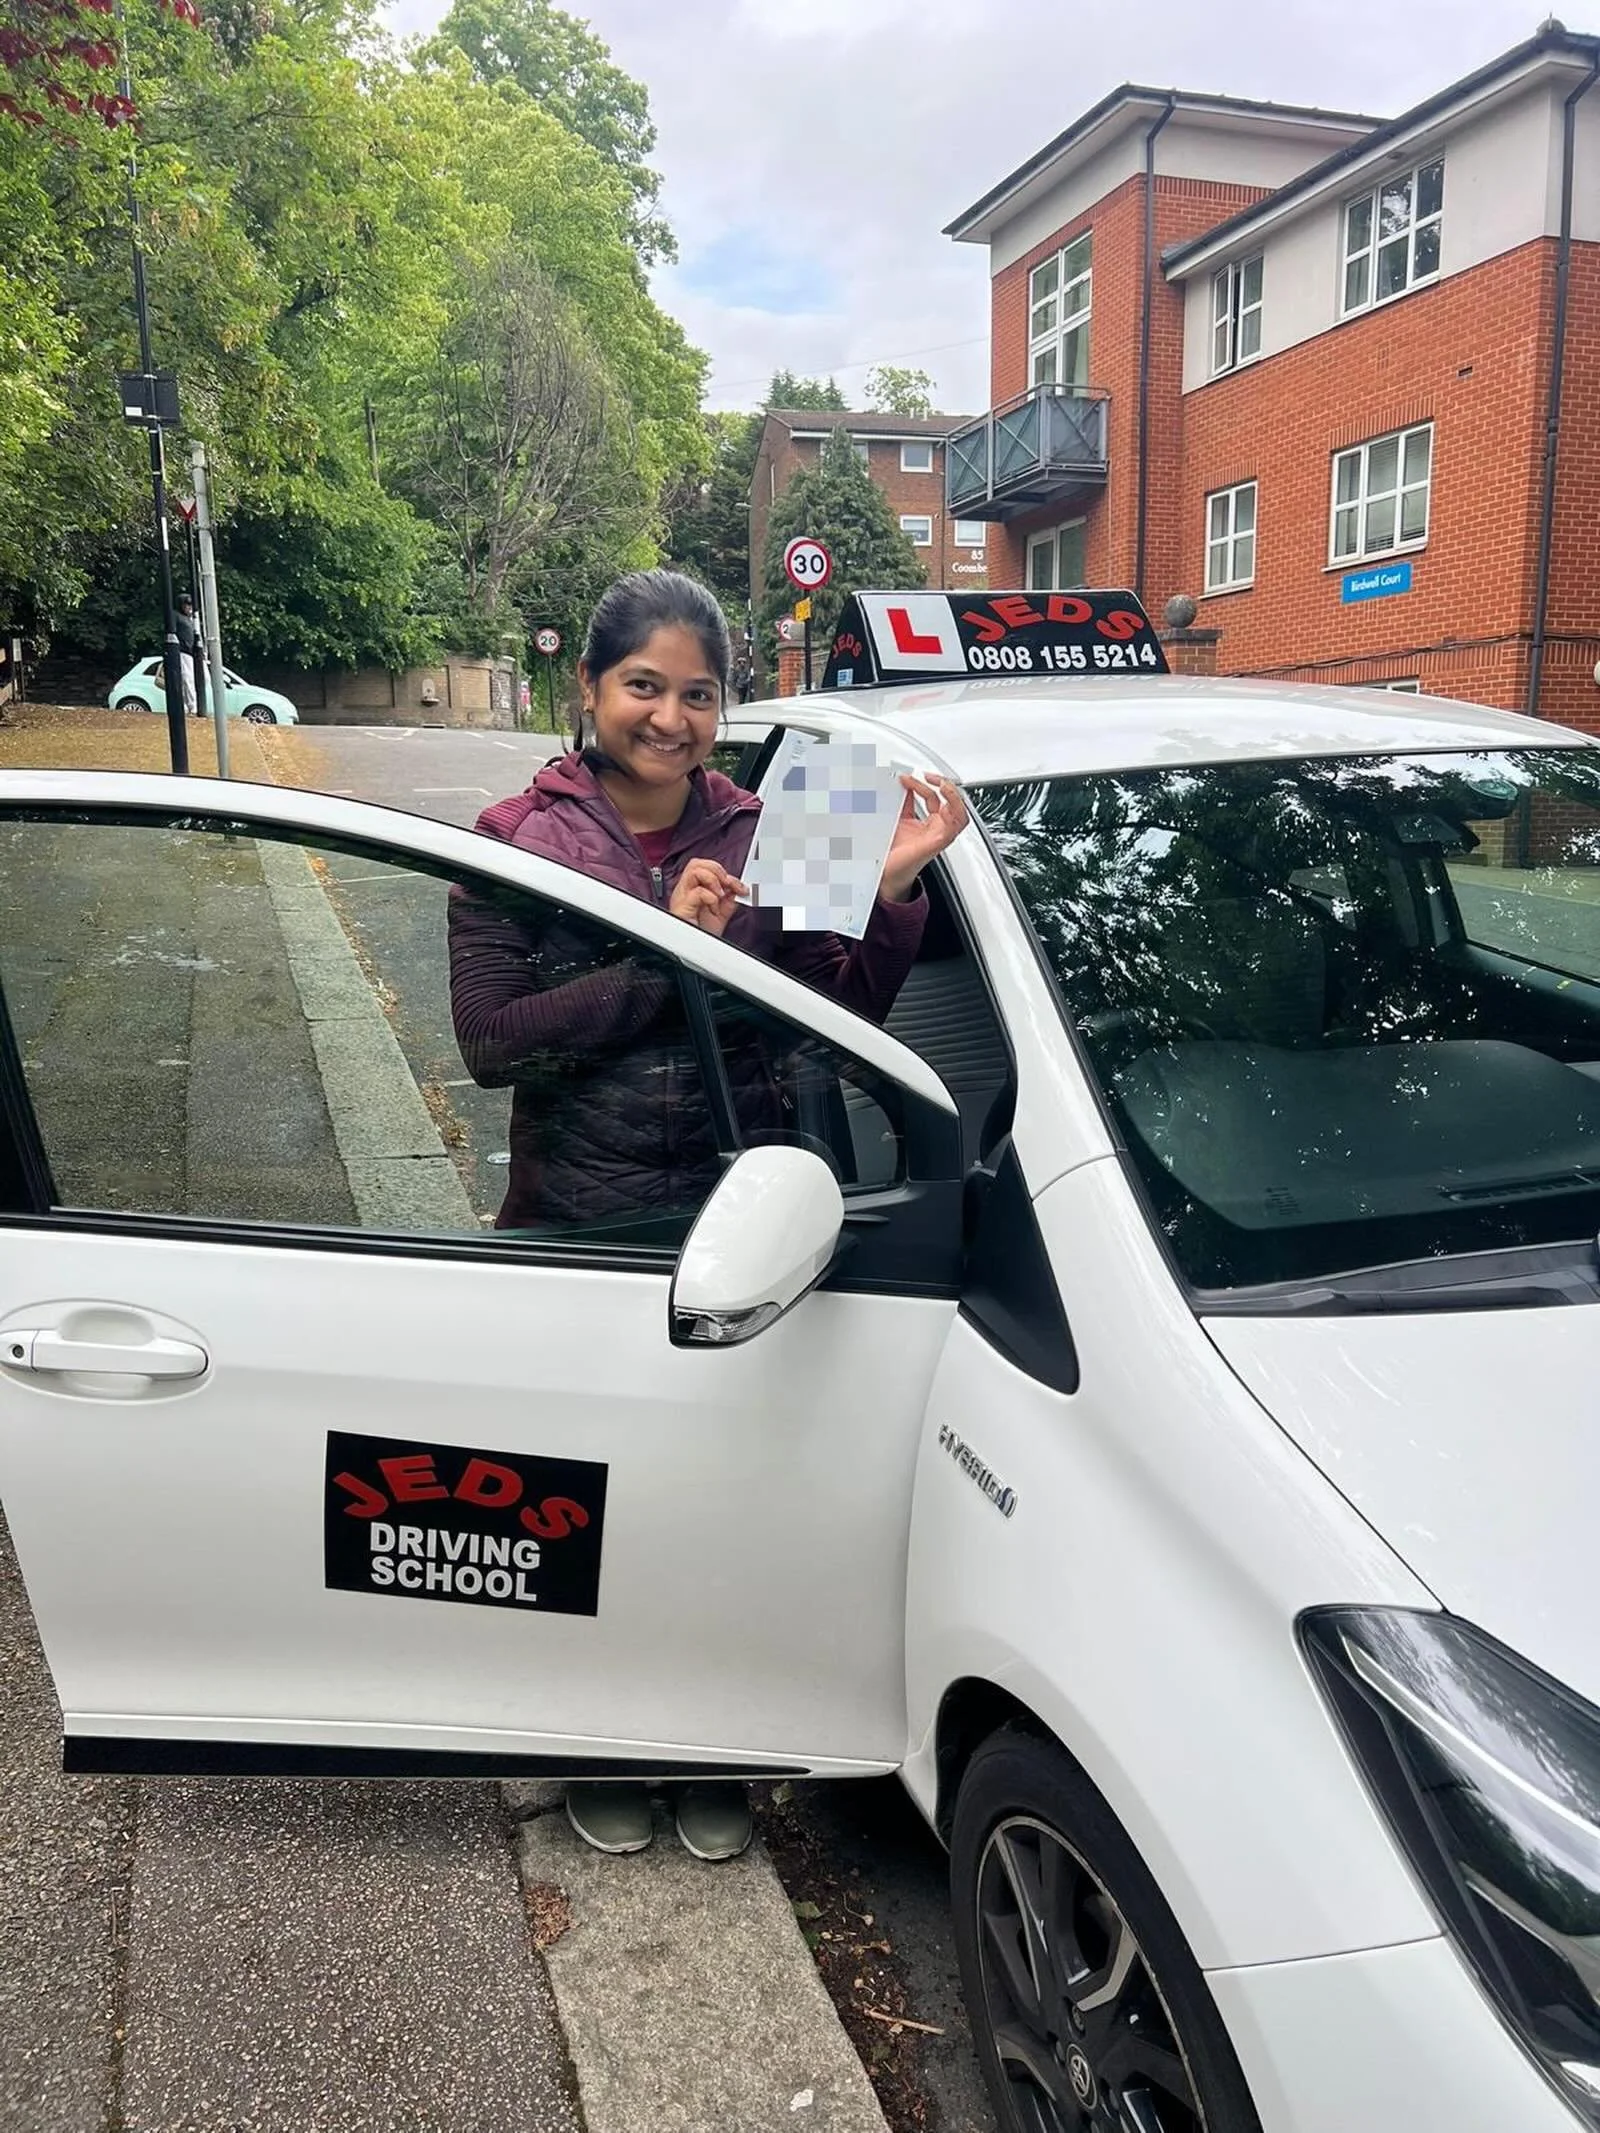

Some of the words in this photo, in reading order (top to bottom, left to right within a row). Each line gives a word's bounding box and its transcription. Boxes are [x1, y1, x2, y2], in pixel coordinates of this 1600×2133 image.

[793, 554, 825, 574] 30
[971, 550, 984, 560] 85
[1380, 573, 1402, 586] Court
[886, 608, 943, 655] L
[960, 595, 1145, 641] JEDS
[541, 635, 558, 647] 20
[832, 634, 862, 660] JEDS
[968, 645, 1033, 670] 0808
[1040, 645, 1087, 669] 155
[1094, 643, 1157, 668] 5214
[333, 1454, 589, 1539] JEDS
[370, 1522, 541, 1570] DRIVING
[371, 1556, 537, 1602] SCHOOL
